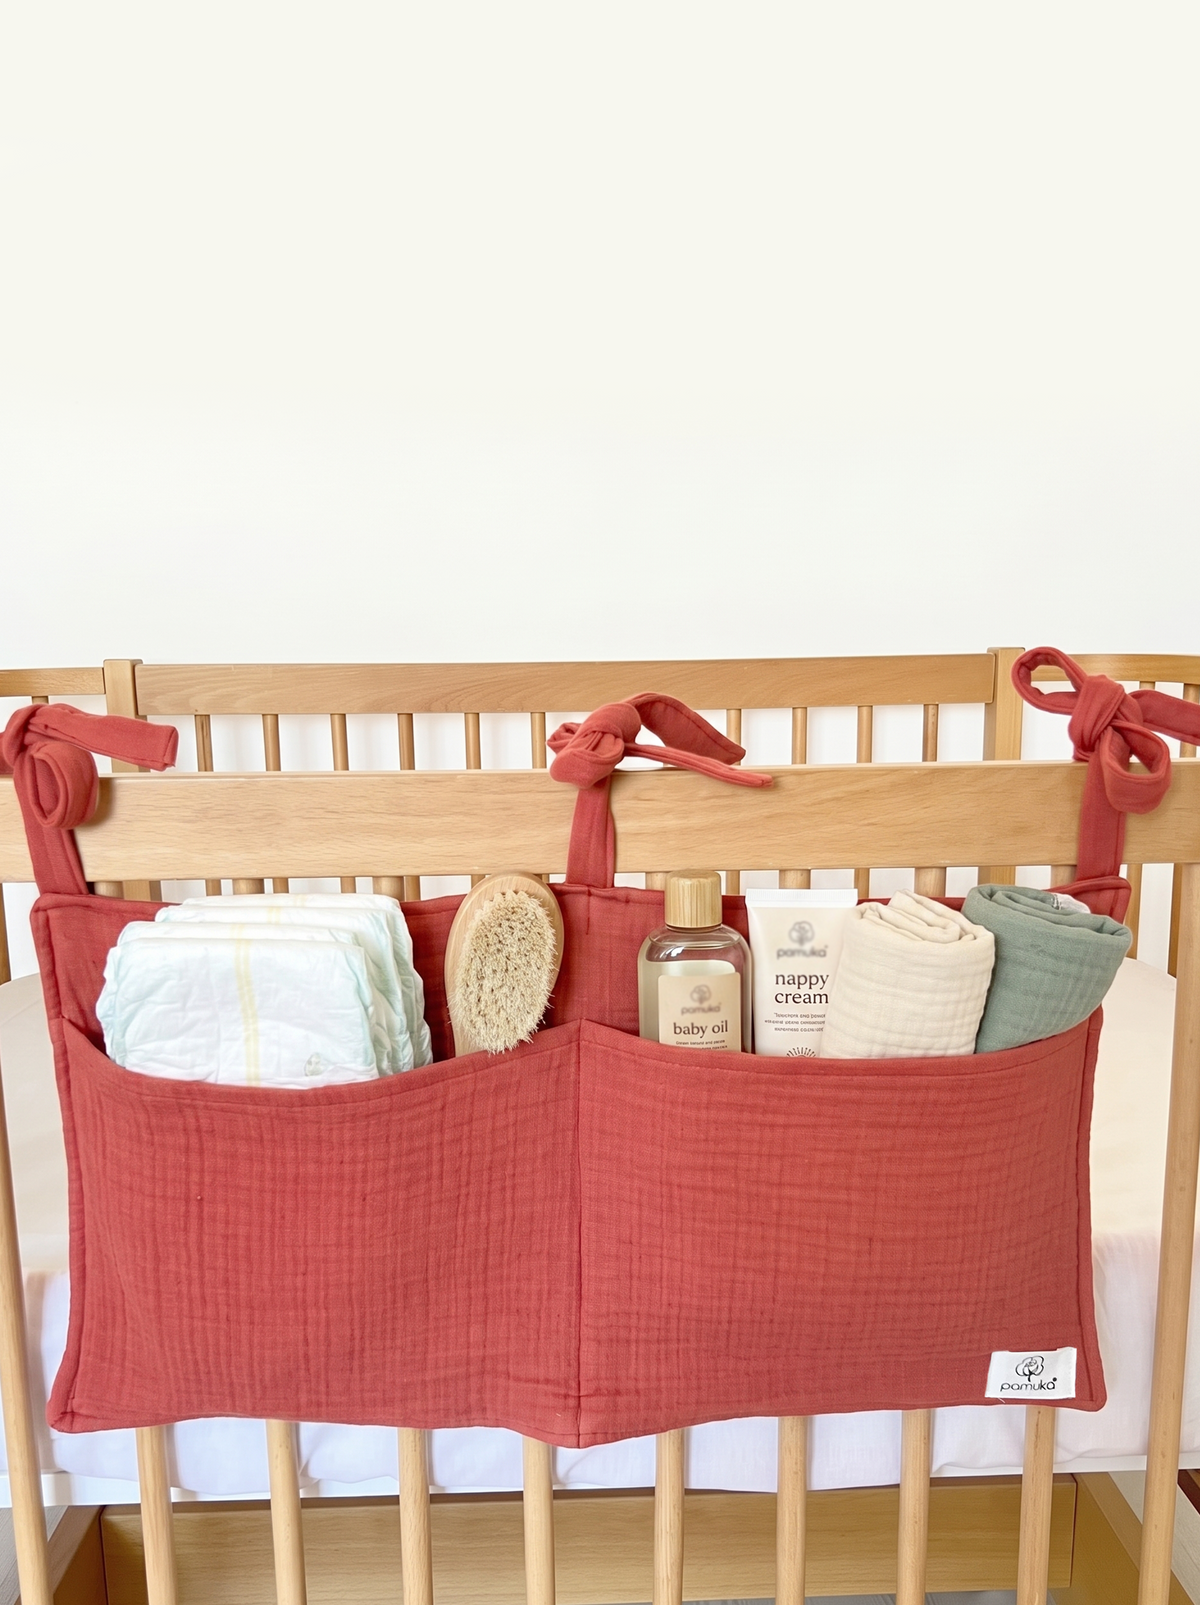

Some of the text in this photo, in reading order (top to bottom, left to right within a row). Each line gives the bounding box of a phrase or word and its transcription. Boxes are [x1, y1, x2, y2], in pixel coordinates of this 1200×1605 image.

[775, 974, 829, 990] nappy
[774, 992, 829, 1004] cream
[673, 1019, 728, 1039] baby oil
